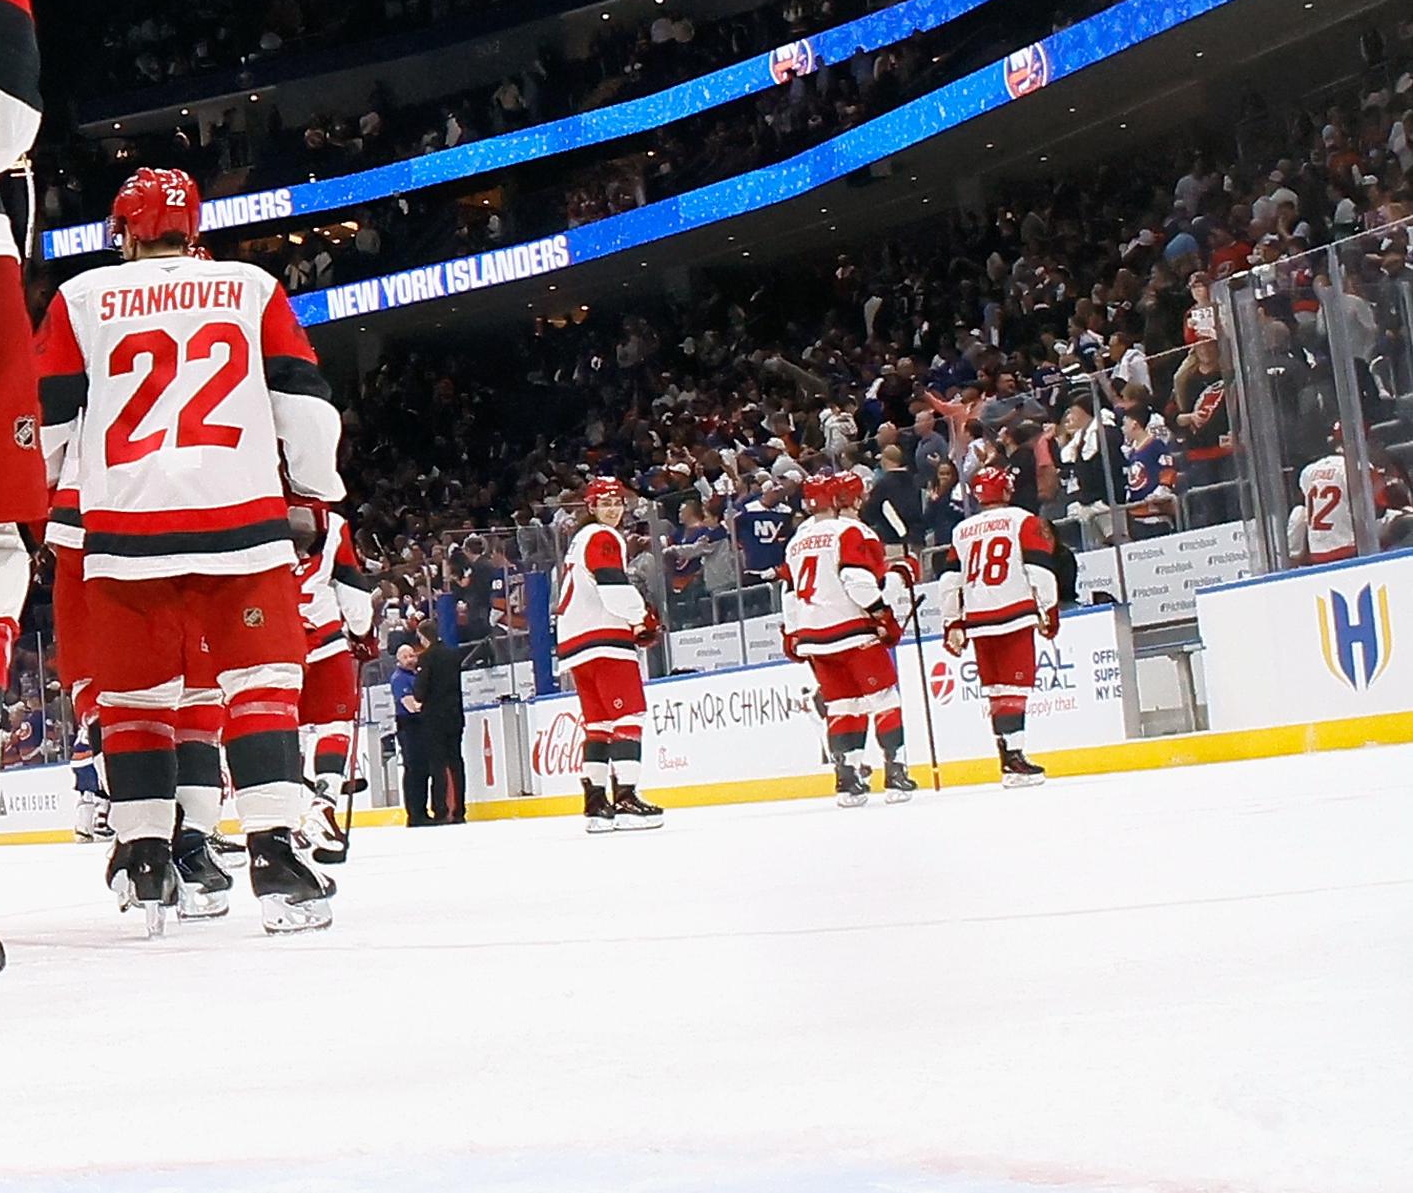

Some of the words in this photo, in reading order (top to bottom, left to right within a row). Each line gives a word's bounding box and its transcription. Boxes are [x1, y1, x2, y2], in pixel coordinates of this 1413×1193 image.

[165, 188, 186, 207] 22
[52, 221, 103, 258] NEW
[199, 188, 293, 232] ANDERS
[326, 278, 380, 320] NEW
[381, 264, 446, 308] YORK
[445, 234, 571, 295] ISLANDERS
[100, 279, 244, 322] STANKOVEN
[105, 321, 249, 470] 22
[796, 556, 819, 605] 4
[967, 535, 1013, 587] 48
[960, 648, 1075, 684] GAL
[652, 700, 684, 736] EAT
[690, 692, 727, 733] MOR
[729, 684, 791, 728] CHIKIN
[1024, 700, 1054, 718] upply
[1095, 686, 1110, 701] NY
[9, 794, 57, 811] ACRISURE
